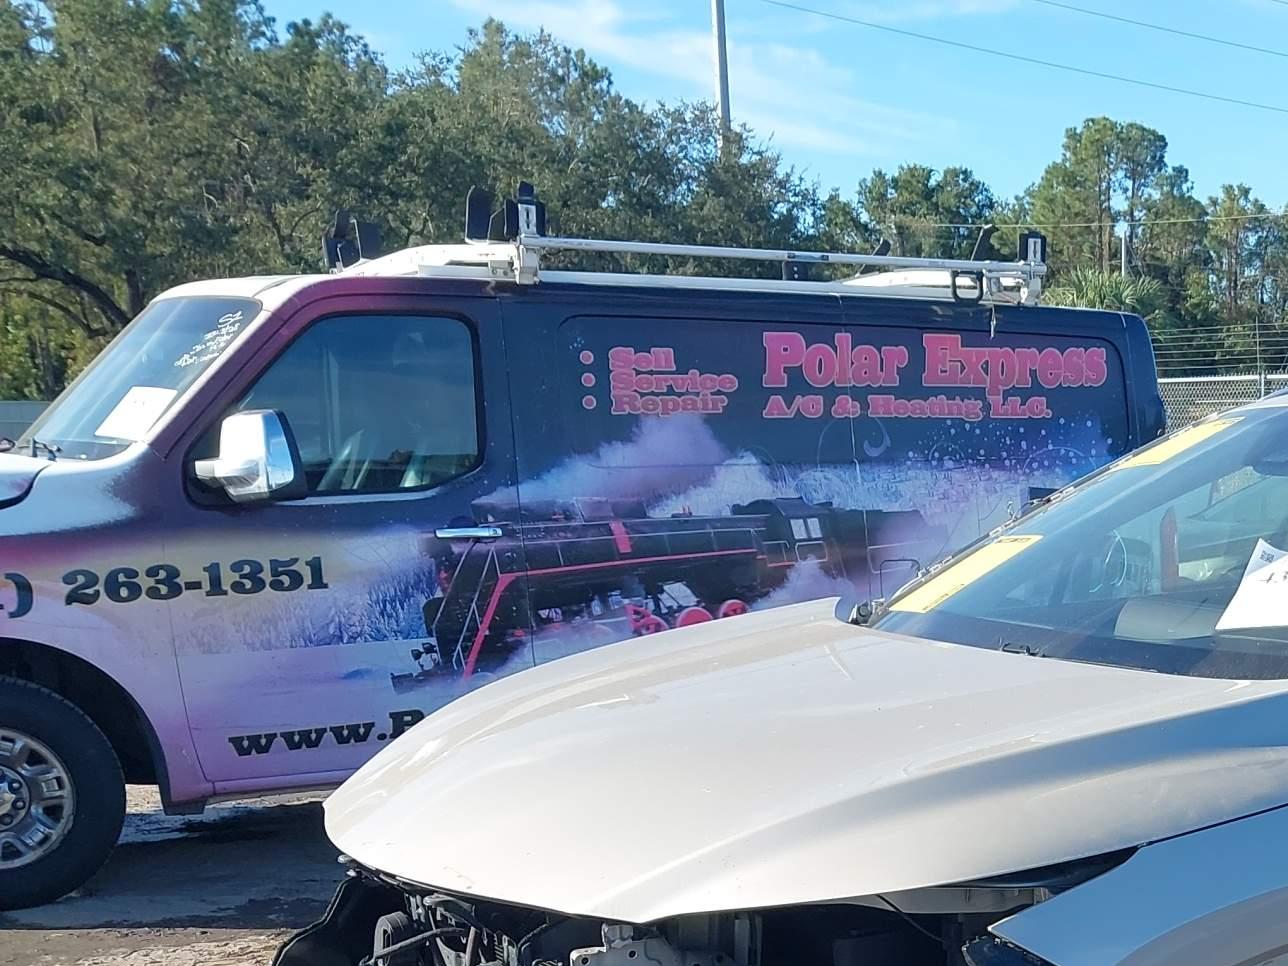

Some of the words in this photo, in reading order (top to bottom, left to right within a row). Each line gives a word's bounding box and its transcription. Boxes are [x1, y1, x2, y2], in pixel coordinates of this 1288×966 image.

[609, 346, 677, 371] Sell
[763, 332, 909, 388] Polar
[922, 333, 1108, 398] Express
[610, 369, 739, 393] Service
[611, 391, 729, 417] Repair
[763, 395, 824, 419] A/C
[831, 395, 861, 418] &
[867, 395, 984, 421] Heating
[989, 396, 1053, 419] LLC.
[61, 556, 329, 607] 263-1351
